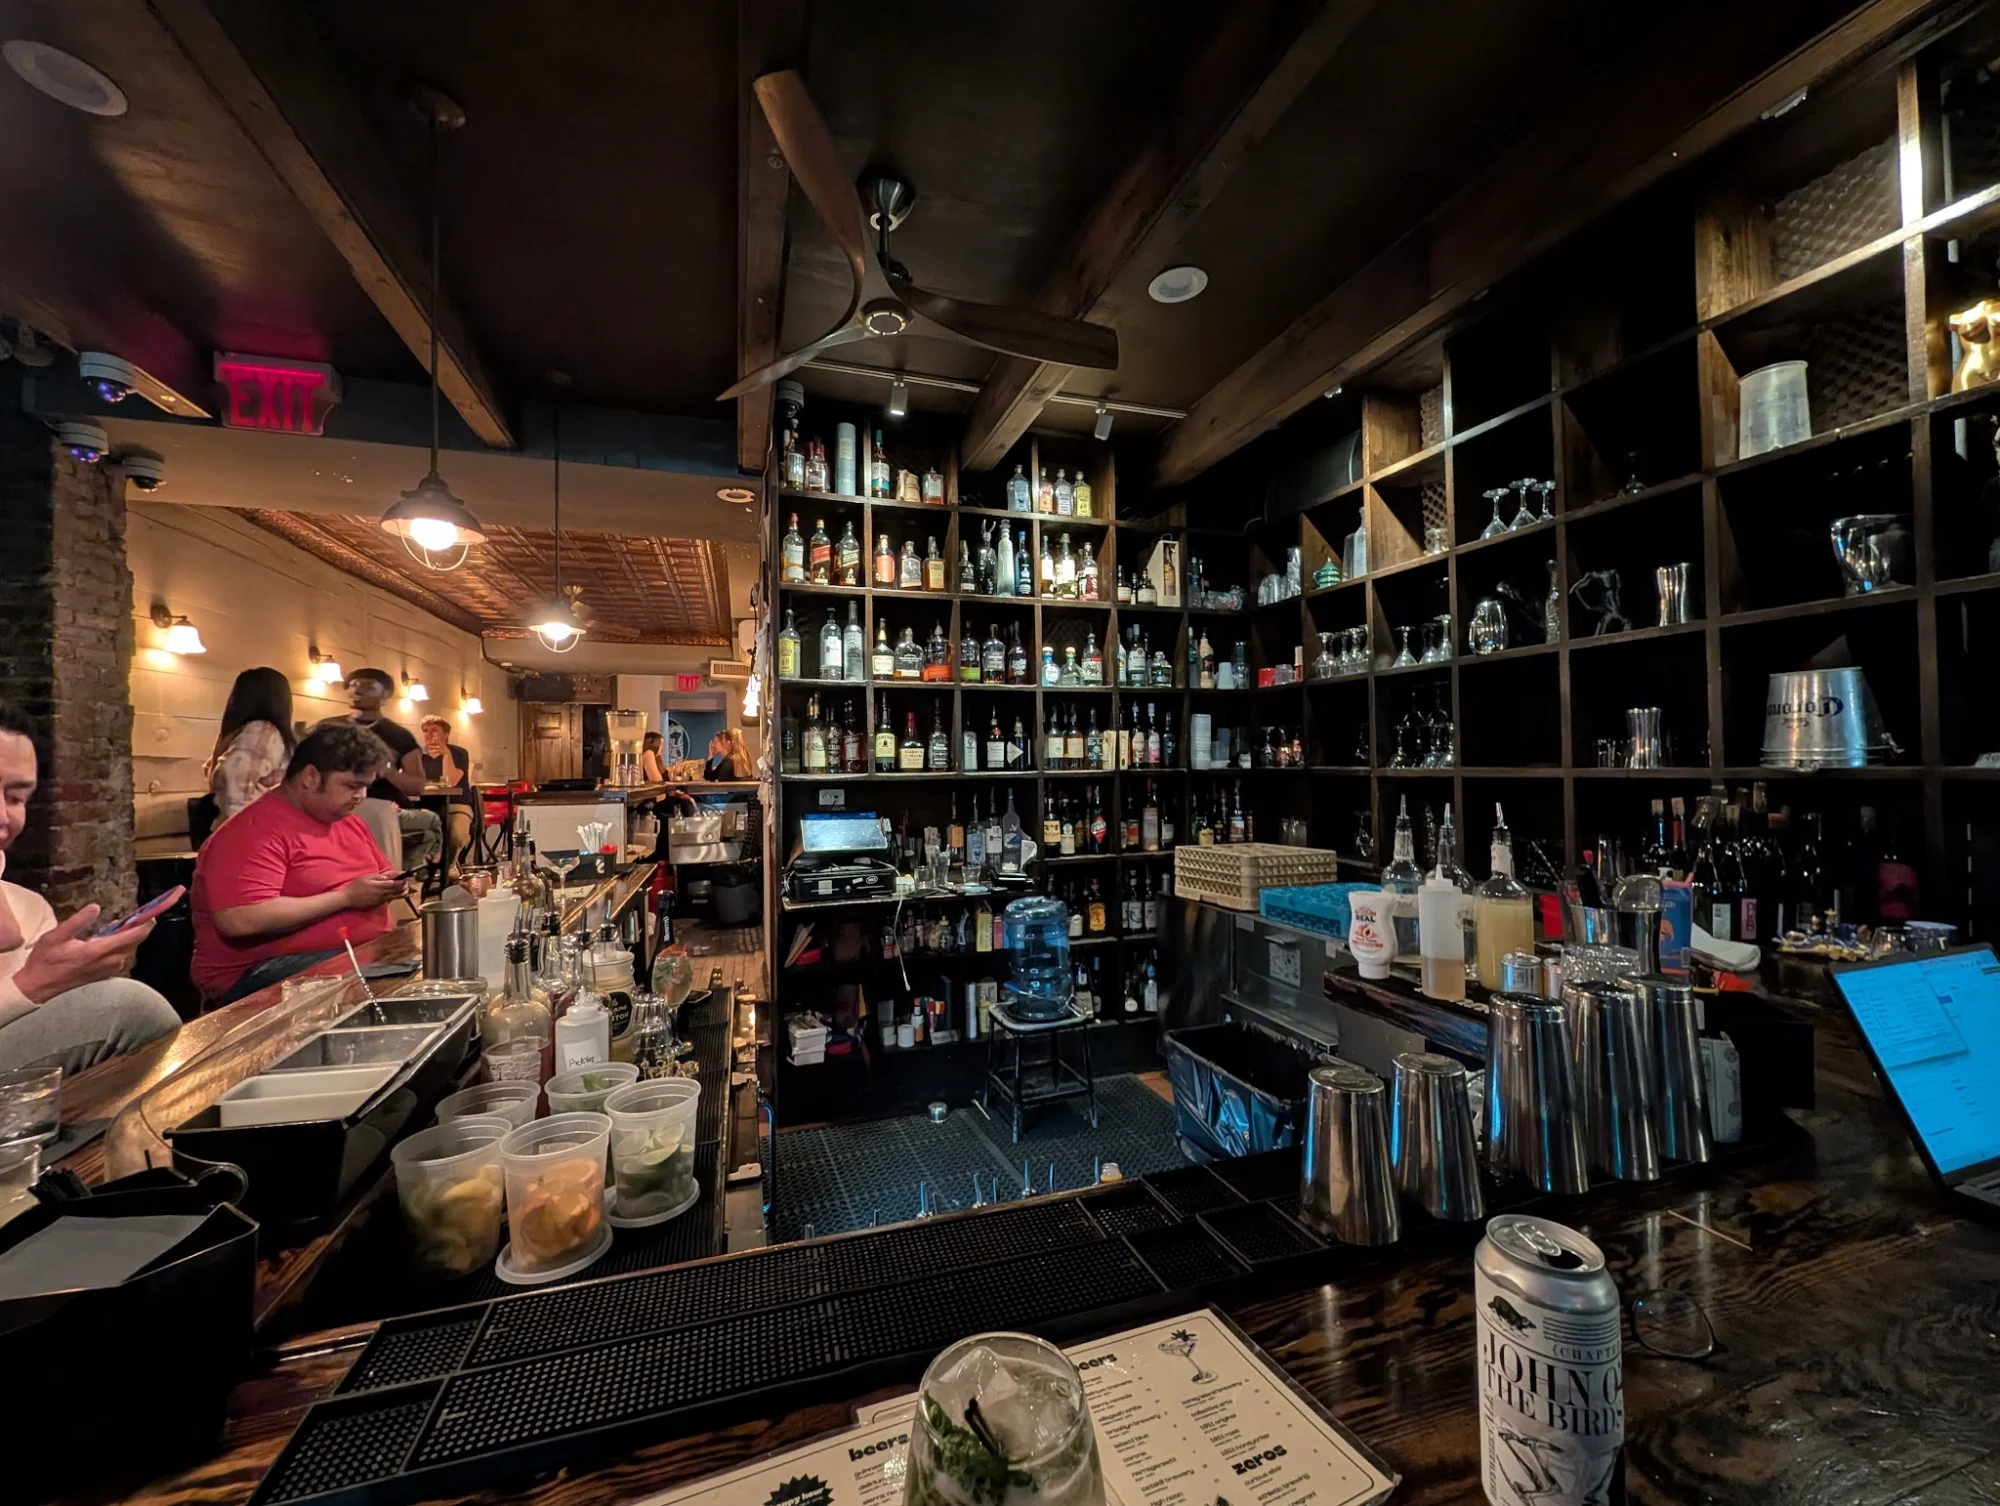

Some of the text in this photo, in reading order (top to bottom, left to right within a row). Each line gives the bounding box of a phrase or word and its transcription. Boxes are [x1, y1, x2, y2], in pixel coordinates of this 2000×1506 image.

[227, 368, 324, 432] EXIT
[678, 675, 700, 691] EXIT
[1355, 914, 1376, 923] REAL
[1076, 1353, 1118, 1373] eers
[1483, 1331, 1594, 1409] JOHN
[1486, 1365, 1537, 1421] THE
[848, 1432, 910, 1463] beers
[1231, 1444, 1288, 1477] zeros
[801, 1487, 824, 1501] hour
